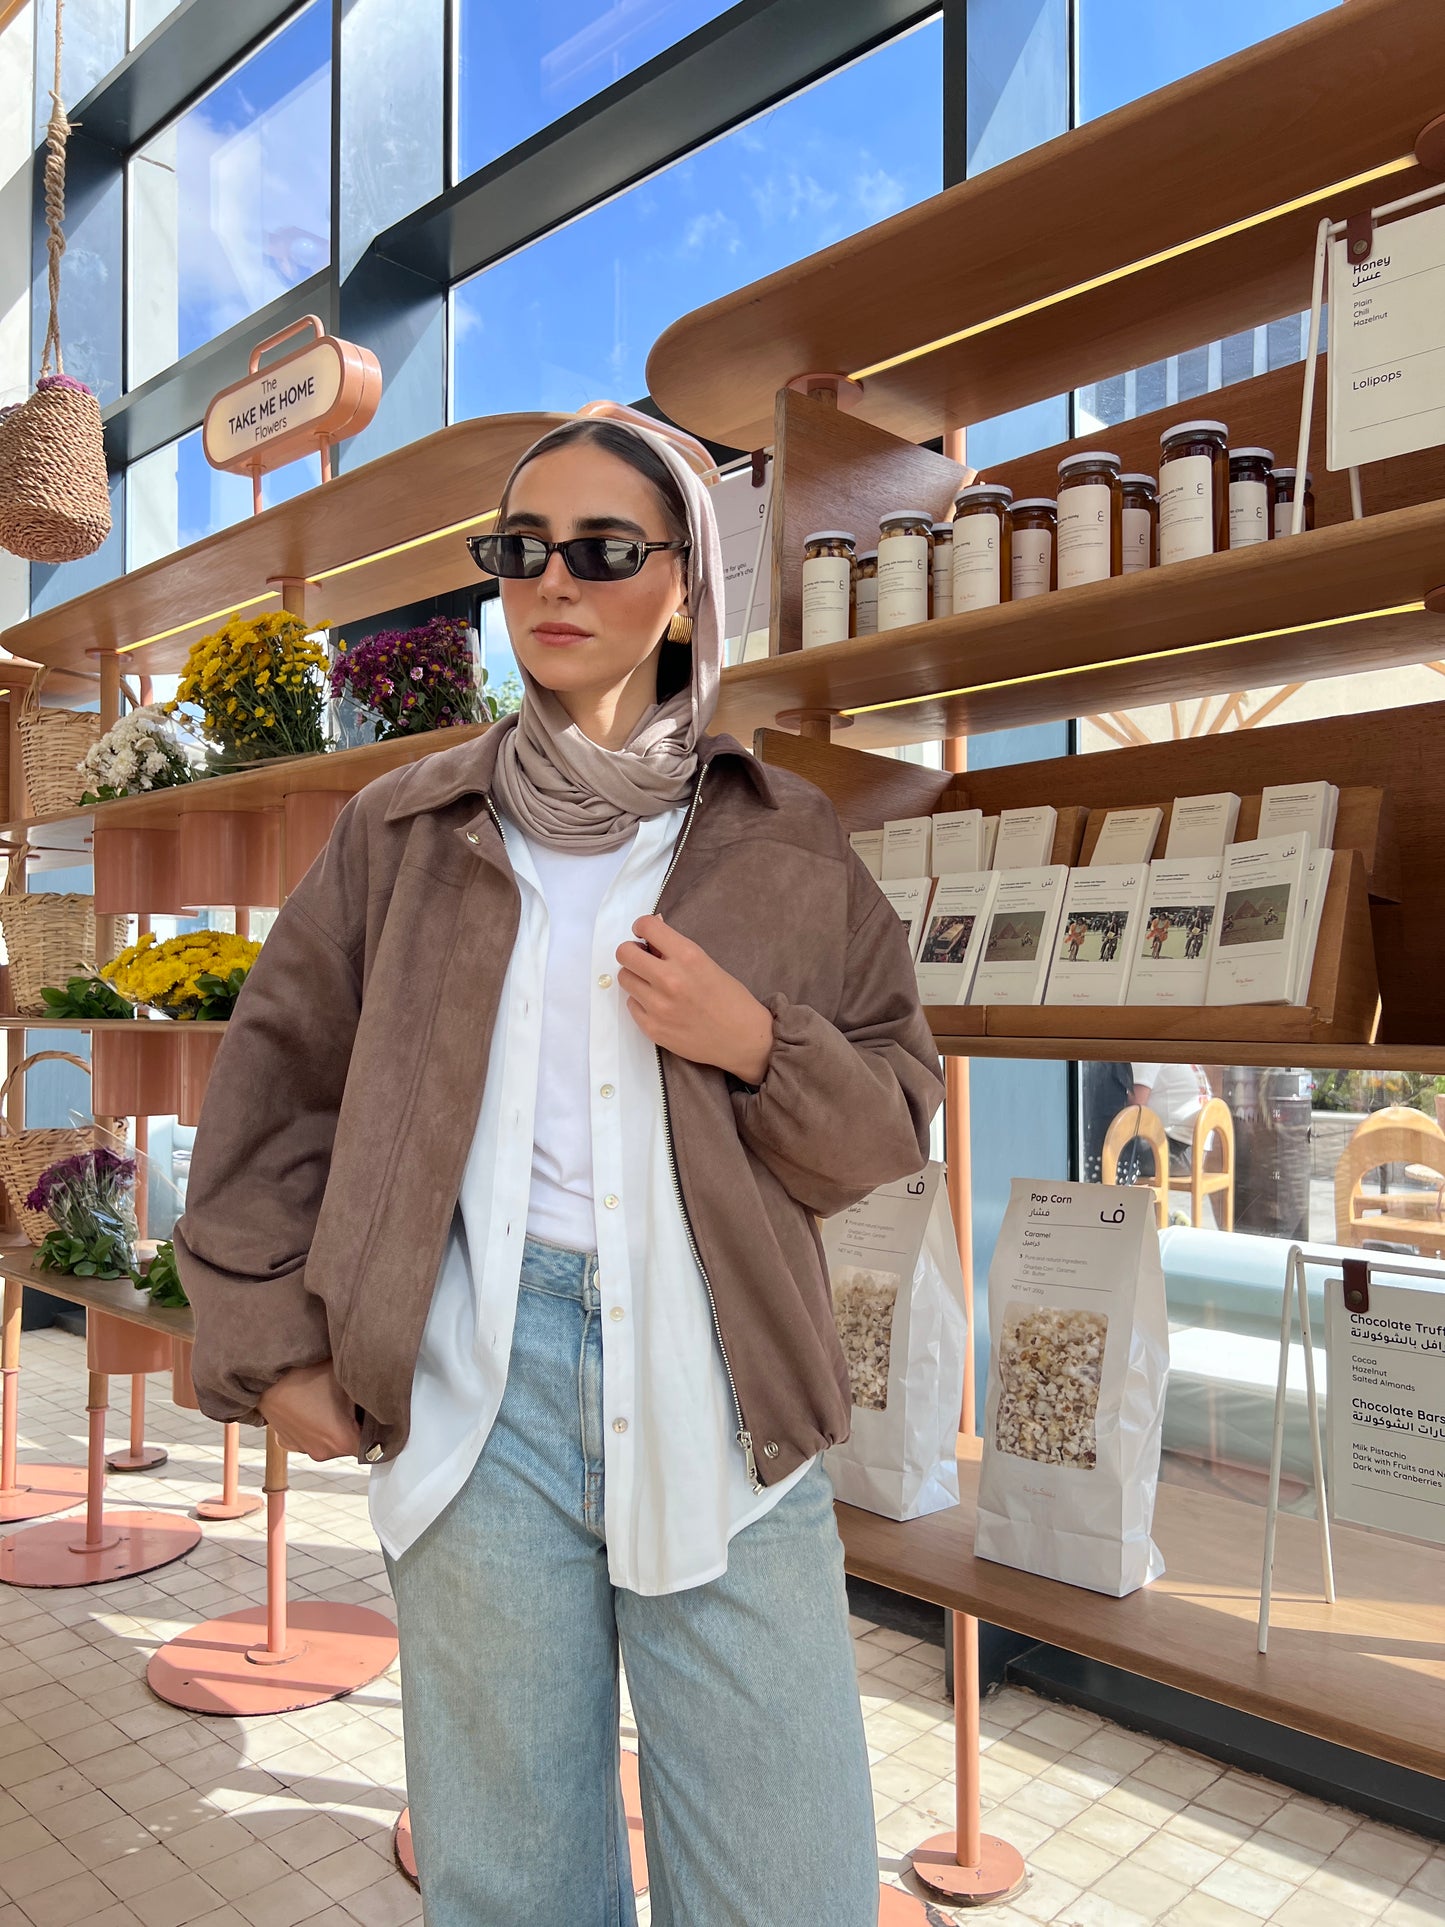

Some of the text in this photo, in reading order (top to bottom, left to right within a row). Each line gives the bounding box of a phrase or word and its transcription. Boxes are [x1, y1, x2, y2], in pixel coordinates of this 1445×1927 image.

[1353, 256, 1391, 275] Honey
[1352, 271, 1381, 288] عسل
[1353, 298, 1373, 309] Plain
[1353, 308, 1370, 318] Chili
[1353, 311, 1388, 327] Hazelnut
[262, 378, 277, 394] The
[1353, 370, 1402, 391] Lolipops
[229, 376, 315, 434] TAKE ME HOME
[255, 416, 287, 441] Flowers
[1030, 1193, 1072, 1204] Pop Corn
[1028, 1207, 1050, 1217] فشار
[1024, 1230, 1051, 1239] Caramel
[1350, 1314, 1412, 1331] Chocolate
[1352, 1355, 1377, 1365] Cocoa
[1352, 1365, 1387, 1377] Hazelnut
[1352, 1374, 1416, 1392] Salted Almonds
[1352, 1398, 1445, 1424] Chocolate Bars
[1352, 1443, 1407, 1460] Milk Pistachio
[1352, 1452, 1372, 1463] Dark
[1374, 1458, 1391, 1466] with
[1393, 1461, 1416, 1472] Fruits
[1418, 1467, 1435, 1476] and
[1352, 1462, 1373, 1472] Dark
[1374, 1467, 1391, 1477] with
[1393, 1471, 1443, 1488] Cranberries
